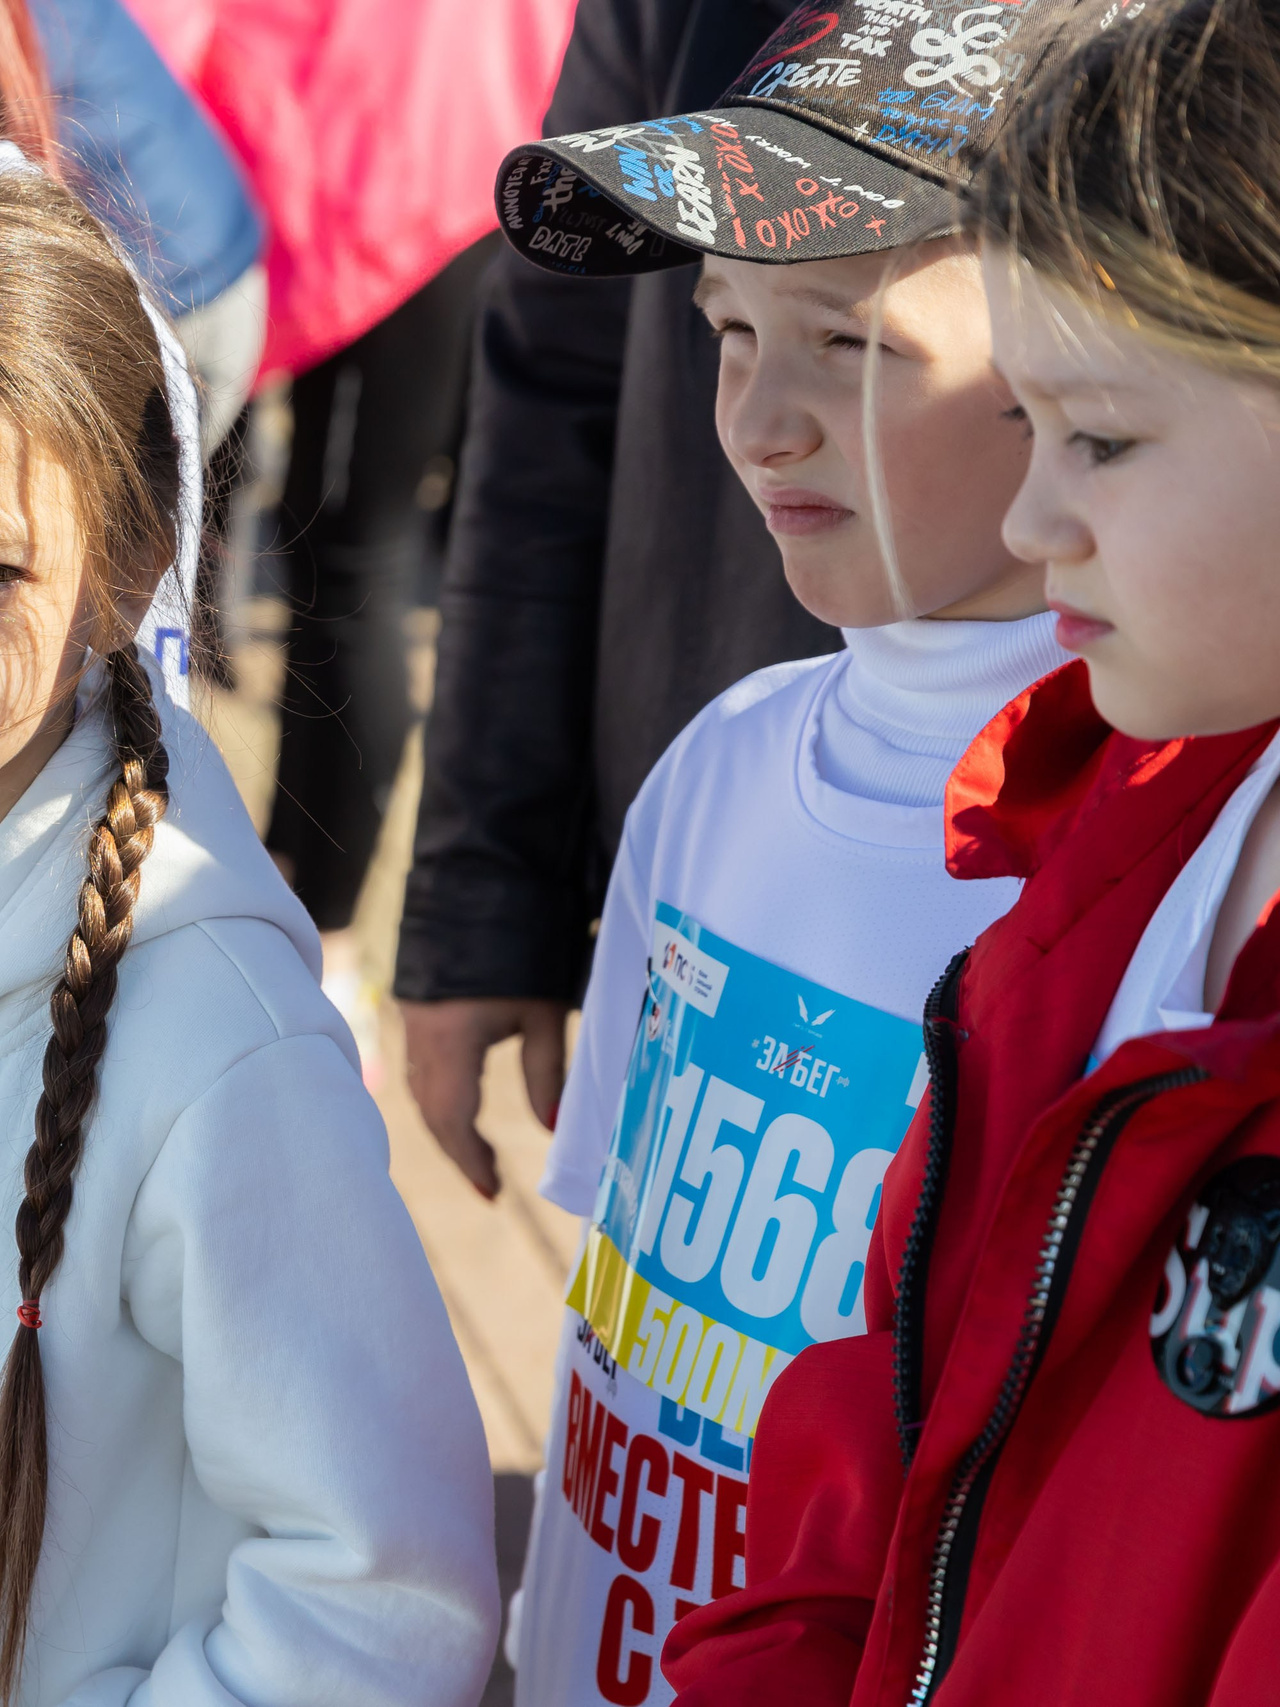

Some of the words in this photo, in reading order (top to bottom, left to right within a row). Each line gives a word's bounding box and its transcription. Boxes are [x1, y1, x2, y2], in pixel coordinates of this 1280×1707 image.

[856, 25, 891, 36] ADD
[863, 10, 904, 28] THEN
[840, 32, 893, 57] TAX
[747, 57, 862, 98] CREATE
[919, 90, 996, 121] GLAM
[745, 135, 811, 169] WORRY
[870, 124, 966, 158] DAMN
[665, 144, 718, 245] LEARN
[528, 226, 592, 262] DATE
[634, 1062, 898, 1342] 1568
